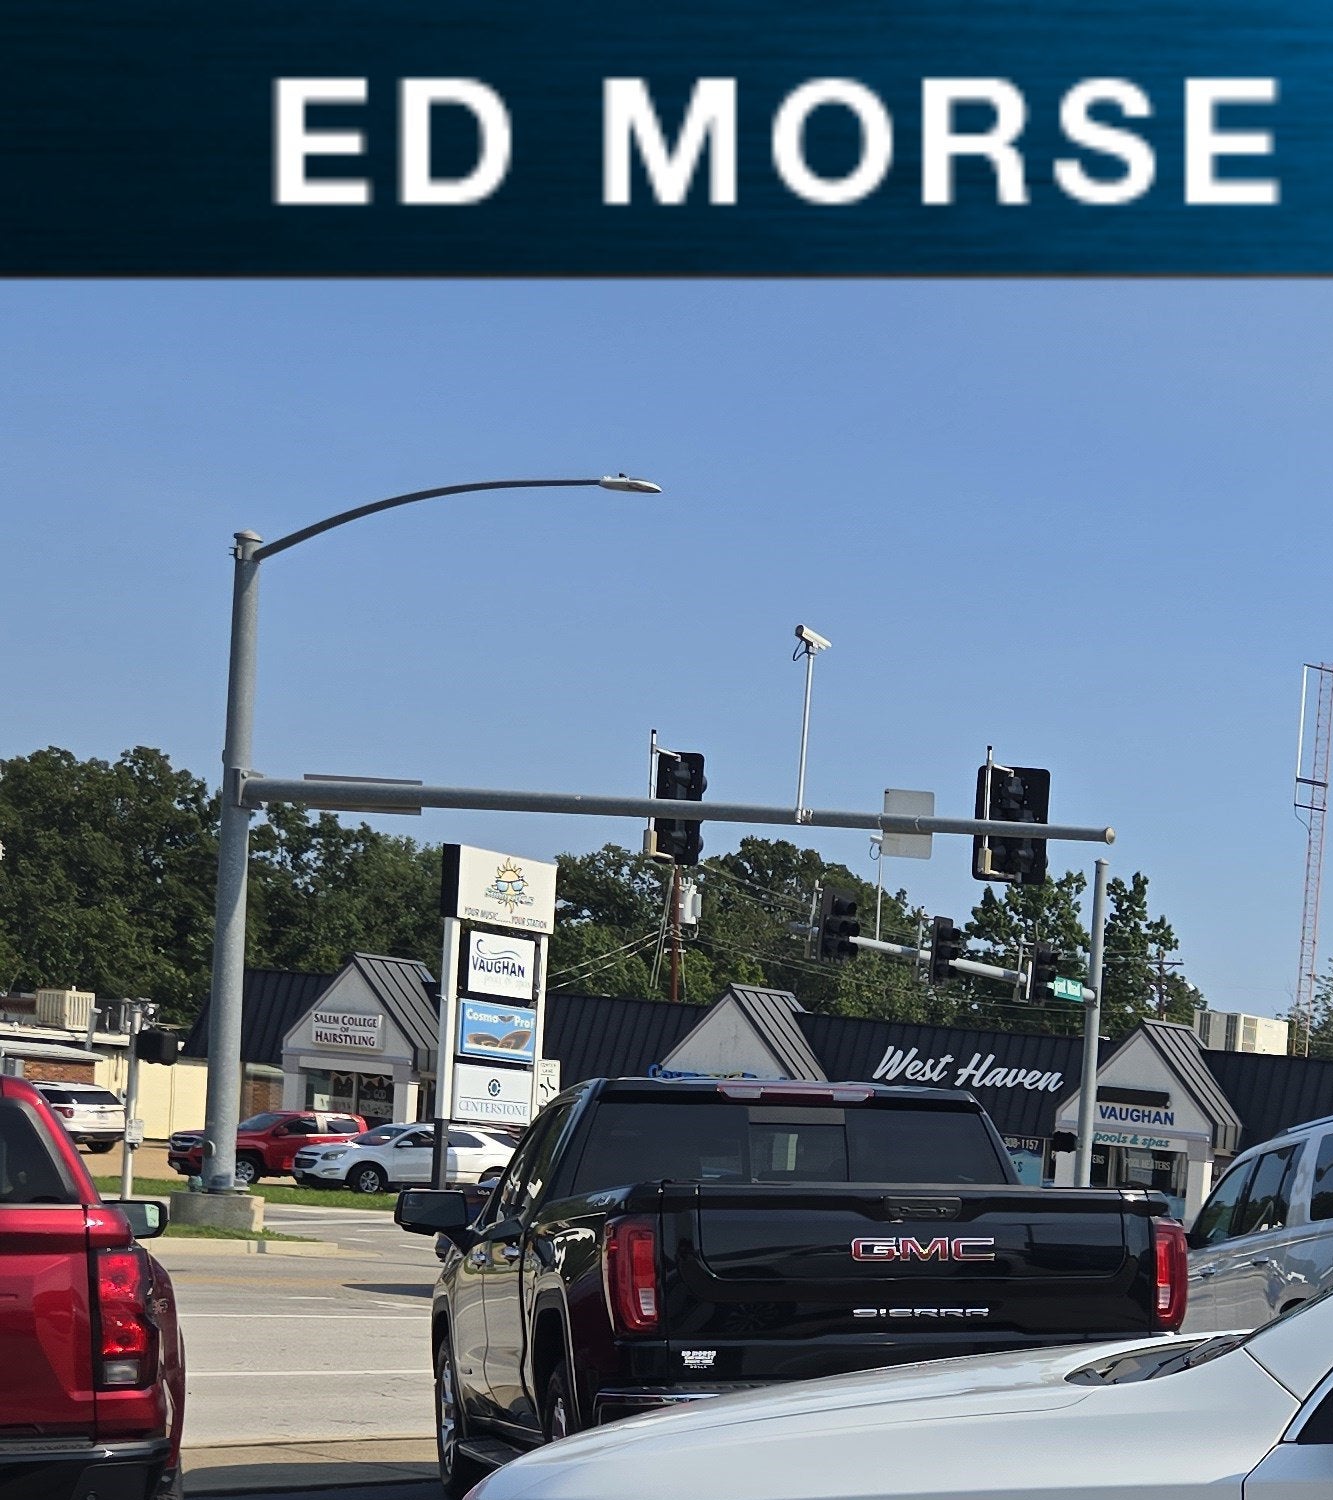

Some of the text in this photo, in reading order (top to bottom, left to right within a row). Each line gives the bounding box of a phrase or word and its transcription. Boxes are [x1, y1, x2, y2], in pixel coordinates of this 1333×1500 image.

[472, 956, 525, 978] VAUGHAN
[314, 1013, 378, 1029] SALEM COLLEGE
[466, 1008, 499, 1024] Cosmo
[315, 1030, 376, 1047] HAIRSTYLING
[872, 1045, 1064, 1092] West Haven
[459, 1100, 528, 1117] CENTERSTONE
[1099, 1104, 1175, 1126] VAUGHAN
[1093, 1131, 1171, 1150] pools & spas
[851, 1236, 996, 1262] GMC
[852, 1307, 990, 1318] SIERRA
